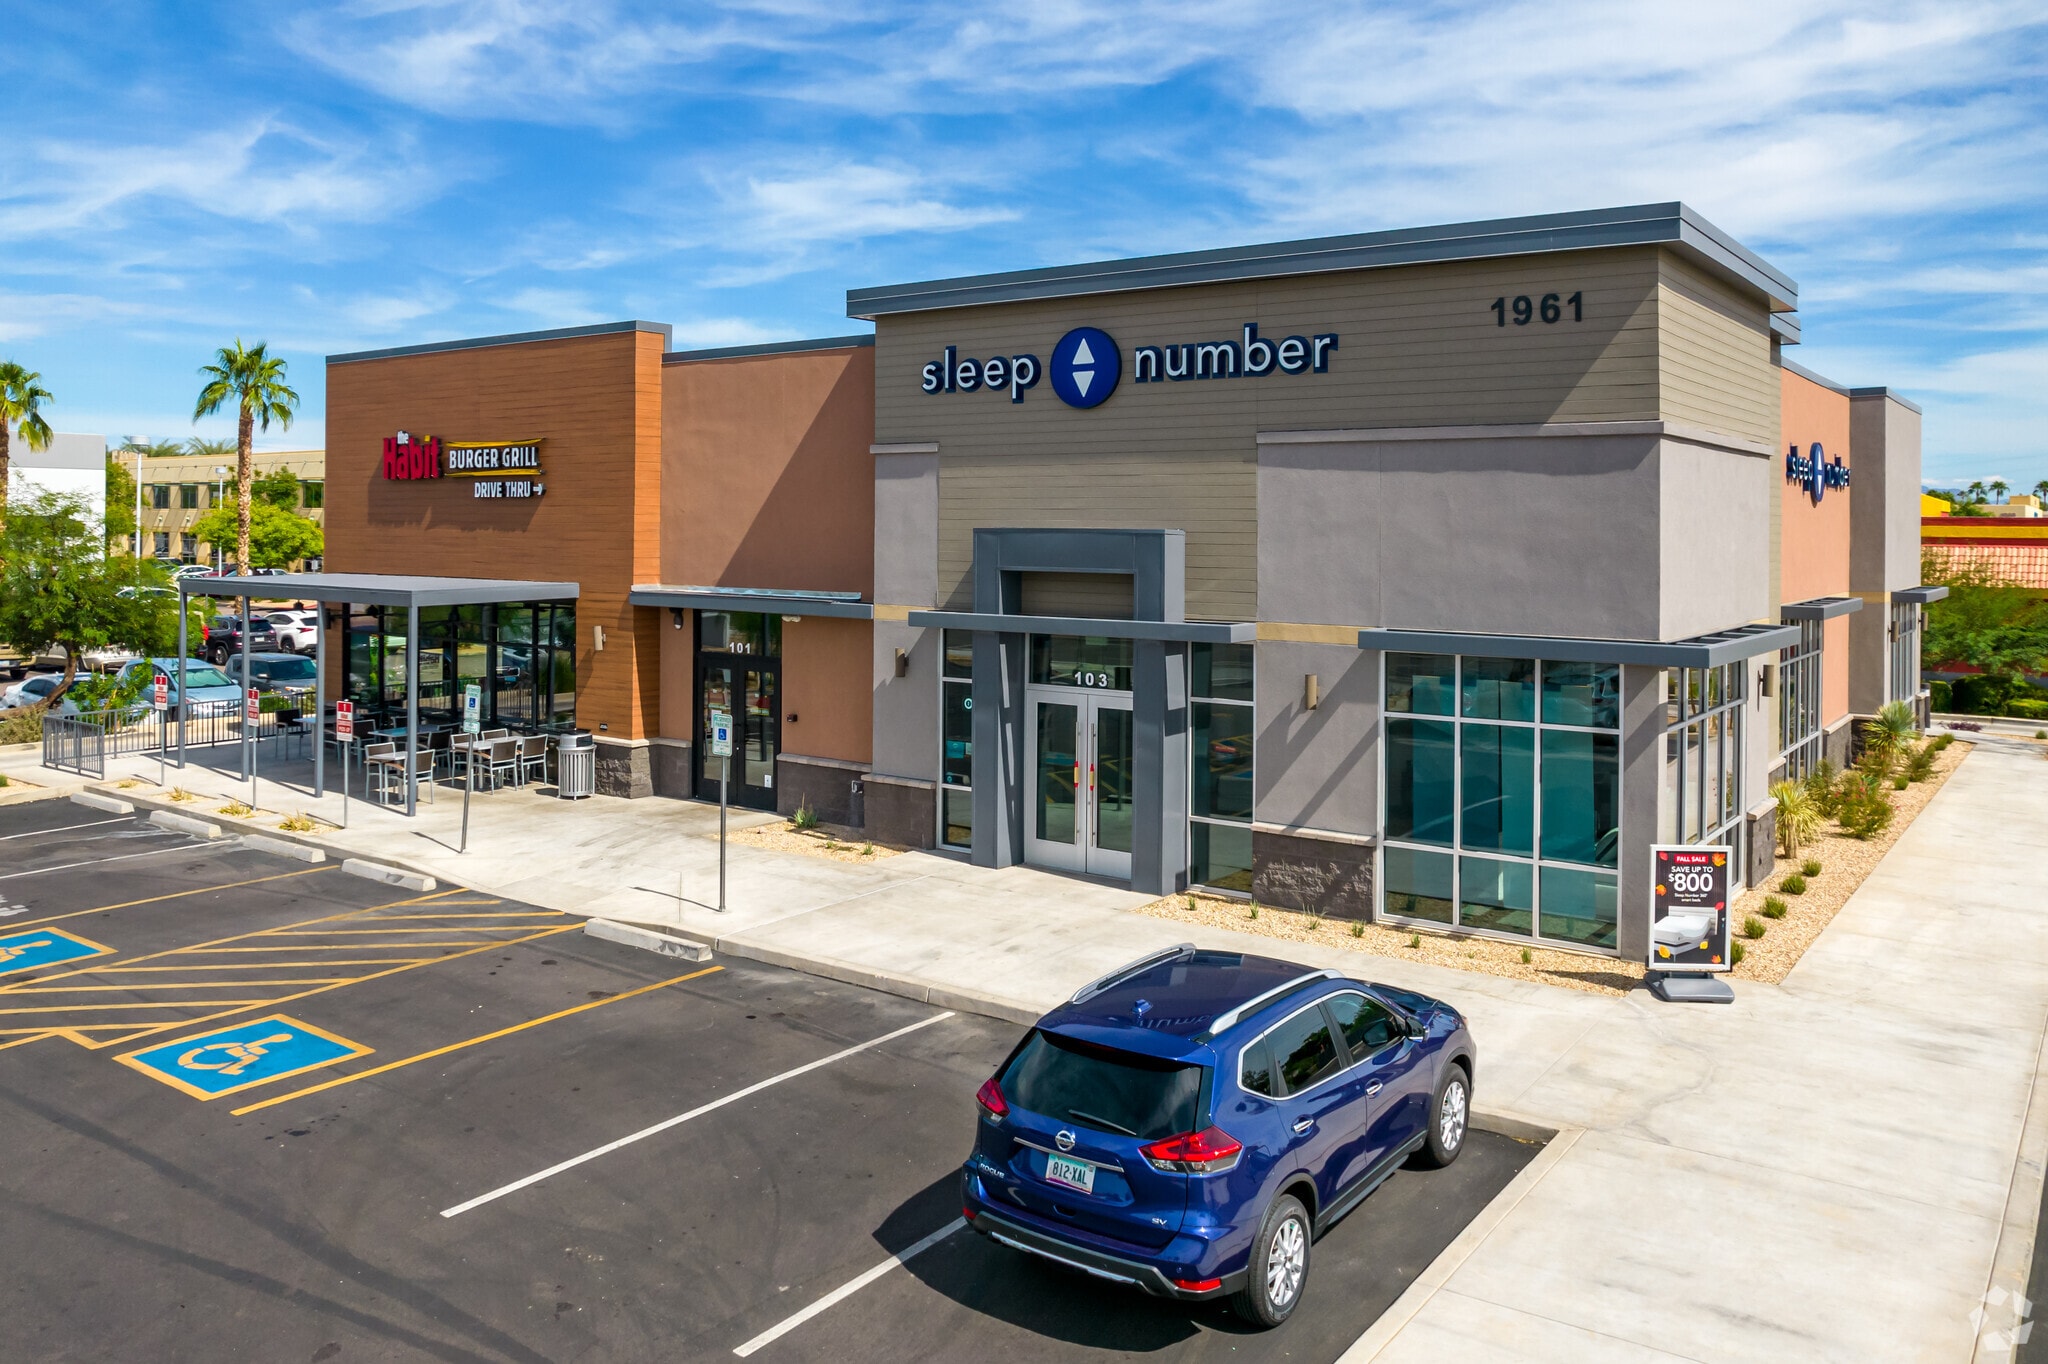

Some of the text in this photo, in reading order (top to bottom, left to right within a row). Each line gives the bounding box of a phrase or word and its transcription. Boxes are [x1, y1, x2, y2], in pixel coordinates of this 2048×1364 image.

[1491, 288, 1582, 328] 1961
[922, 323, 1338, 403] sleep number
[397, 430, 409, 444] the
[383, 435, 440, 480] Habit
[449, 447, 538, 469] BURGER GRILL
[474, 481, 531, 498] DRIVE THRU
[729, 641, 751, 654] 101
[1074, 671, 1108, 687] 103
[1668, 872, 1713, 892] $800
